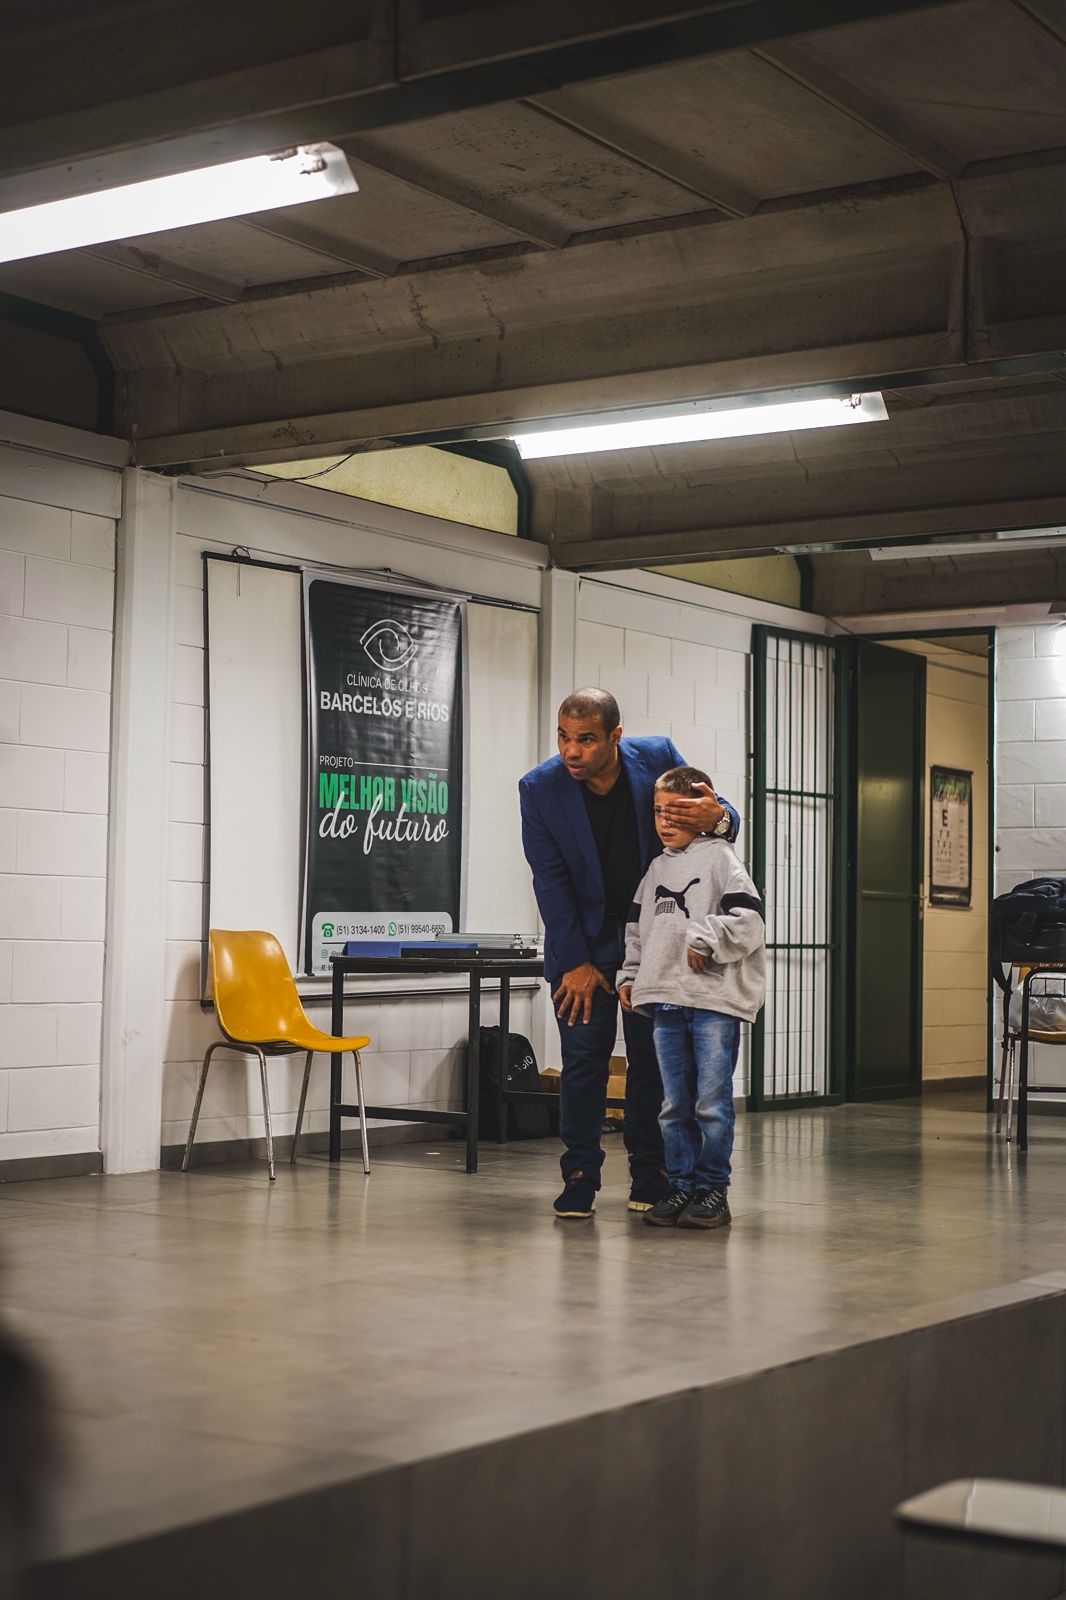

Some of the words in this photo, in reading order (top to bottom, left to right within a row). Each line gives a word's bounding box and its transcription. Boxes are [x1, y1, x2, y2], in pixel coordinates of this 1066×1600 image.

[347, 671, 382, 689] CLÍNICA
[384, 677, 396, 691] DE
[398, 679, 428, 695] OLHOS
[320, 690, 402, 718] BARCELOS
[405, 700, 415, 719] E
[418, 702, 450, 723] RIOS
[319, 755, 354, 768] PROJETO
[319, 772, 396, 813] MELHOR
[401, 773, 449, 814] VISÃO
[318, 791, 359, 839] do
[363, 793, 450, 855] futuro
[336, 925, 349, 936] (51)
[350, 925, 385, 935] 3134-1400
[398, 924, 410, 936] (51)
